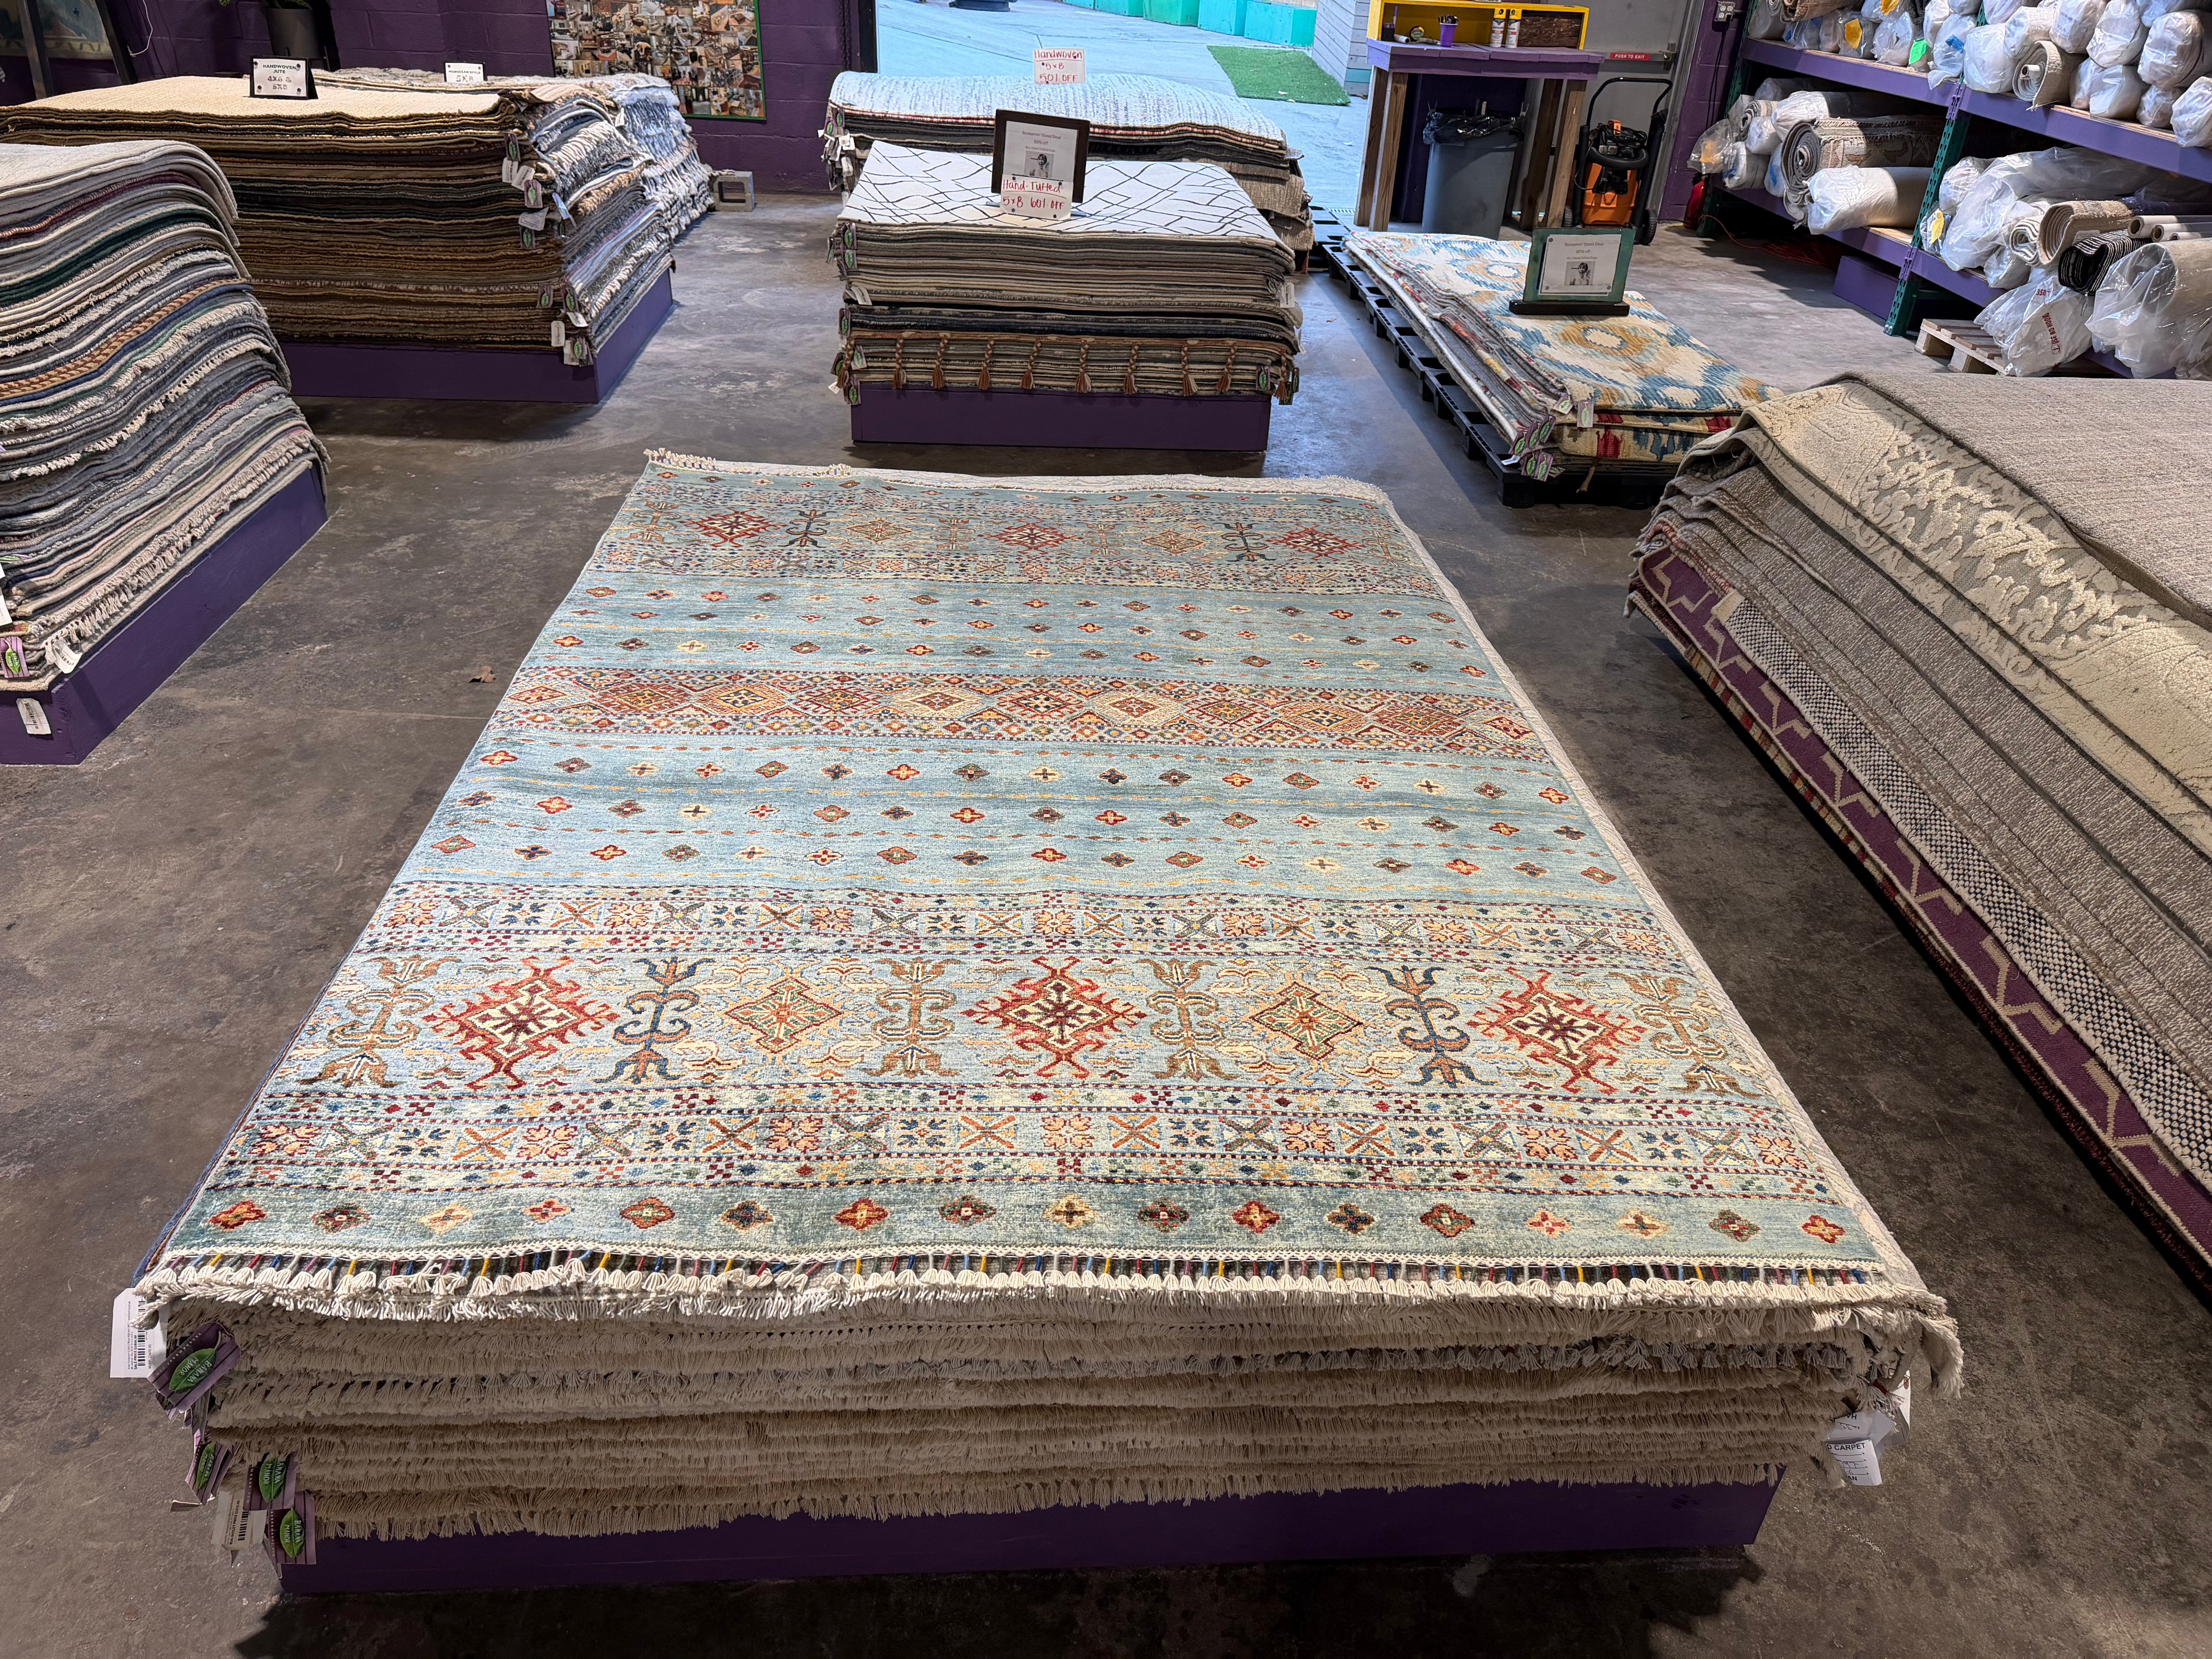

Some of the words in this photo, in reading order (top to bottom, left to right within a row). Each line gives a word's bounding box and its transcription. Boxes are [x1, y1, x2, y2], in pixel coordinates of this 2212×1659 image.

[1034, 50, 1082, 59] Handwoven
[2050, 335, 2059, 344] USE
[179, 1357, 199, 1376] MANOR
[187, 1360, 212, 1382] BANANA
[1834, 1443, 1865, 1451] CARPET
[263, 1463, 272, 1485] MANOR
